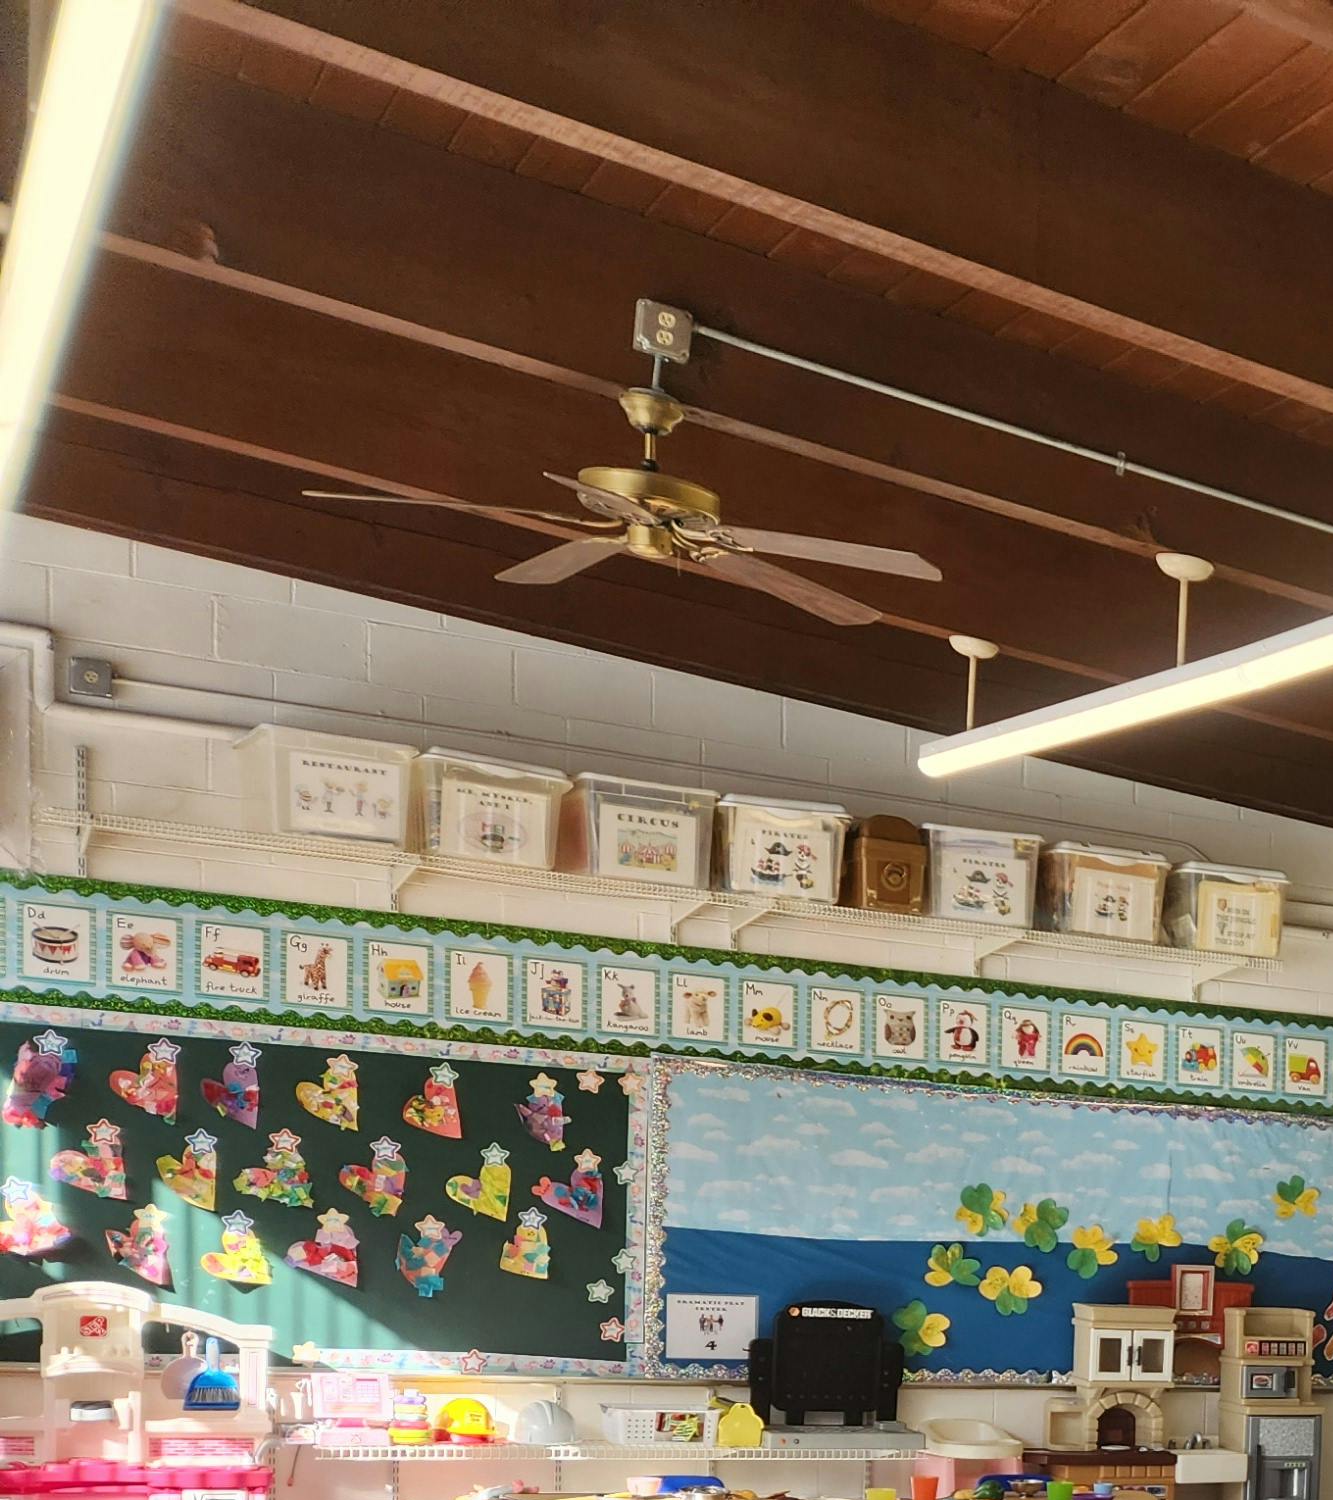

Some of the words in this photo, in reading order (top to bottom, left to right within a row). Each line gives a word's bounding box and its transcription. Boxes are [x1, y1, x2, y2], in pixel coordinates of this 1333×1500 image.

[302, 760, 388, 776] RESTAURANT
[617, 812, 680, 829] CIRCUS
[761, 829, 809, 840] PIRATES
[962, 858, 1006, 868] PIRATES
[27, 906, 46, 919] Dd
[116, 918, 134, 929] Ee
[204, 926, 221, 940] Ff
[289, 935, 308, 952] Gg
[371, 944, 388, 957] Hh
[455, 953, 466, 966] Ii
[43, 967, 69, 976] drum
[530, 961, 545, 980] Jj
[603, 969, 619, 981] Kk
[120, 974, 168, 986] elephant
[676, 976, 688, 988] Ll
[205, 981, 228, 993] fire
[230, 983, 257, 994] truck
[745, 983, 764, 996] Mm
[298, 993, 334, 1003] giraffe
[812, 990, 828, 1002] Nn
[384, 1000, 412, 1009] house
[878, 997, 892, 1009] Oo
[455, 1007, 470, 1015] ice
[475, 1009, 502, 1018] cream
[942, 1003, 955, 1016] Pp
[1004, 1010, 1017, 1025] Qq
[686, 1027, 708, 1037] lamb
[1181, 1028, 1193, 1039] Tt
[1287, 1040, 1298, 1049] Vv
[705, 1340, 718, 1351] 4
